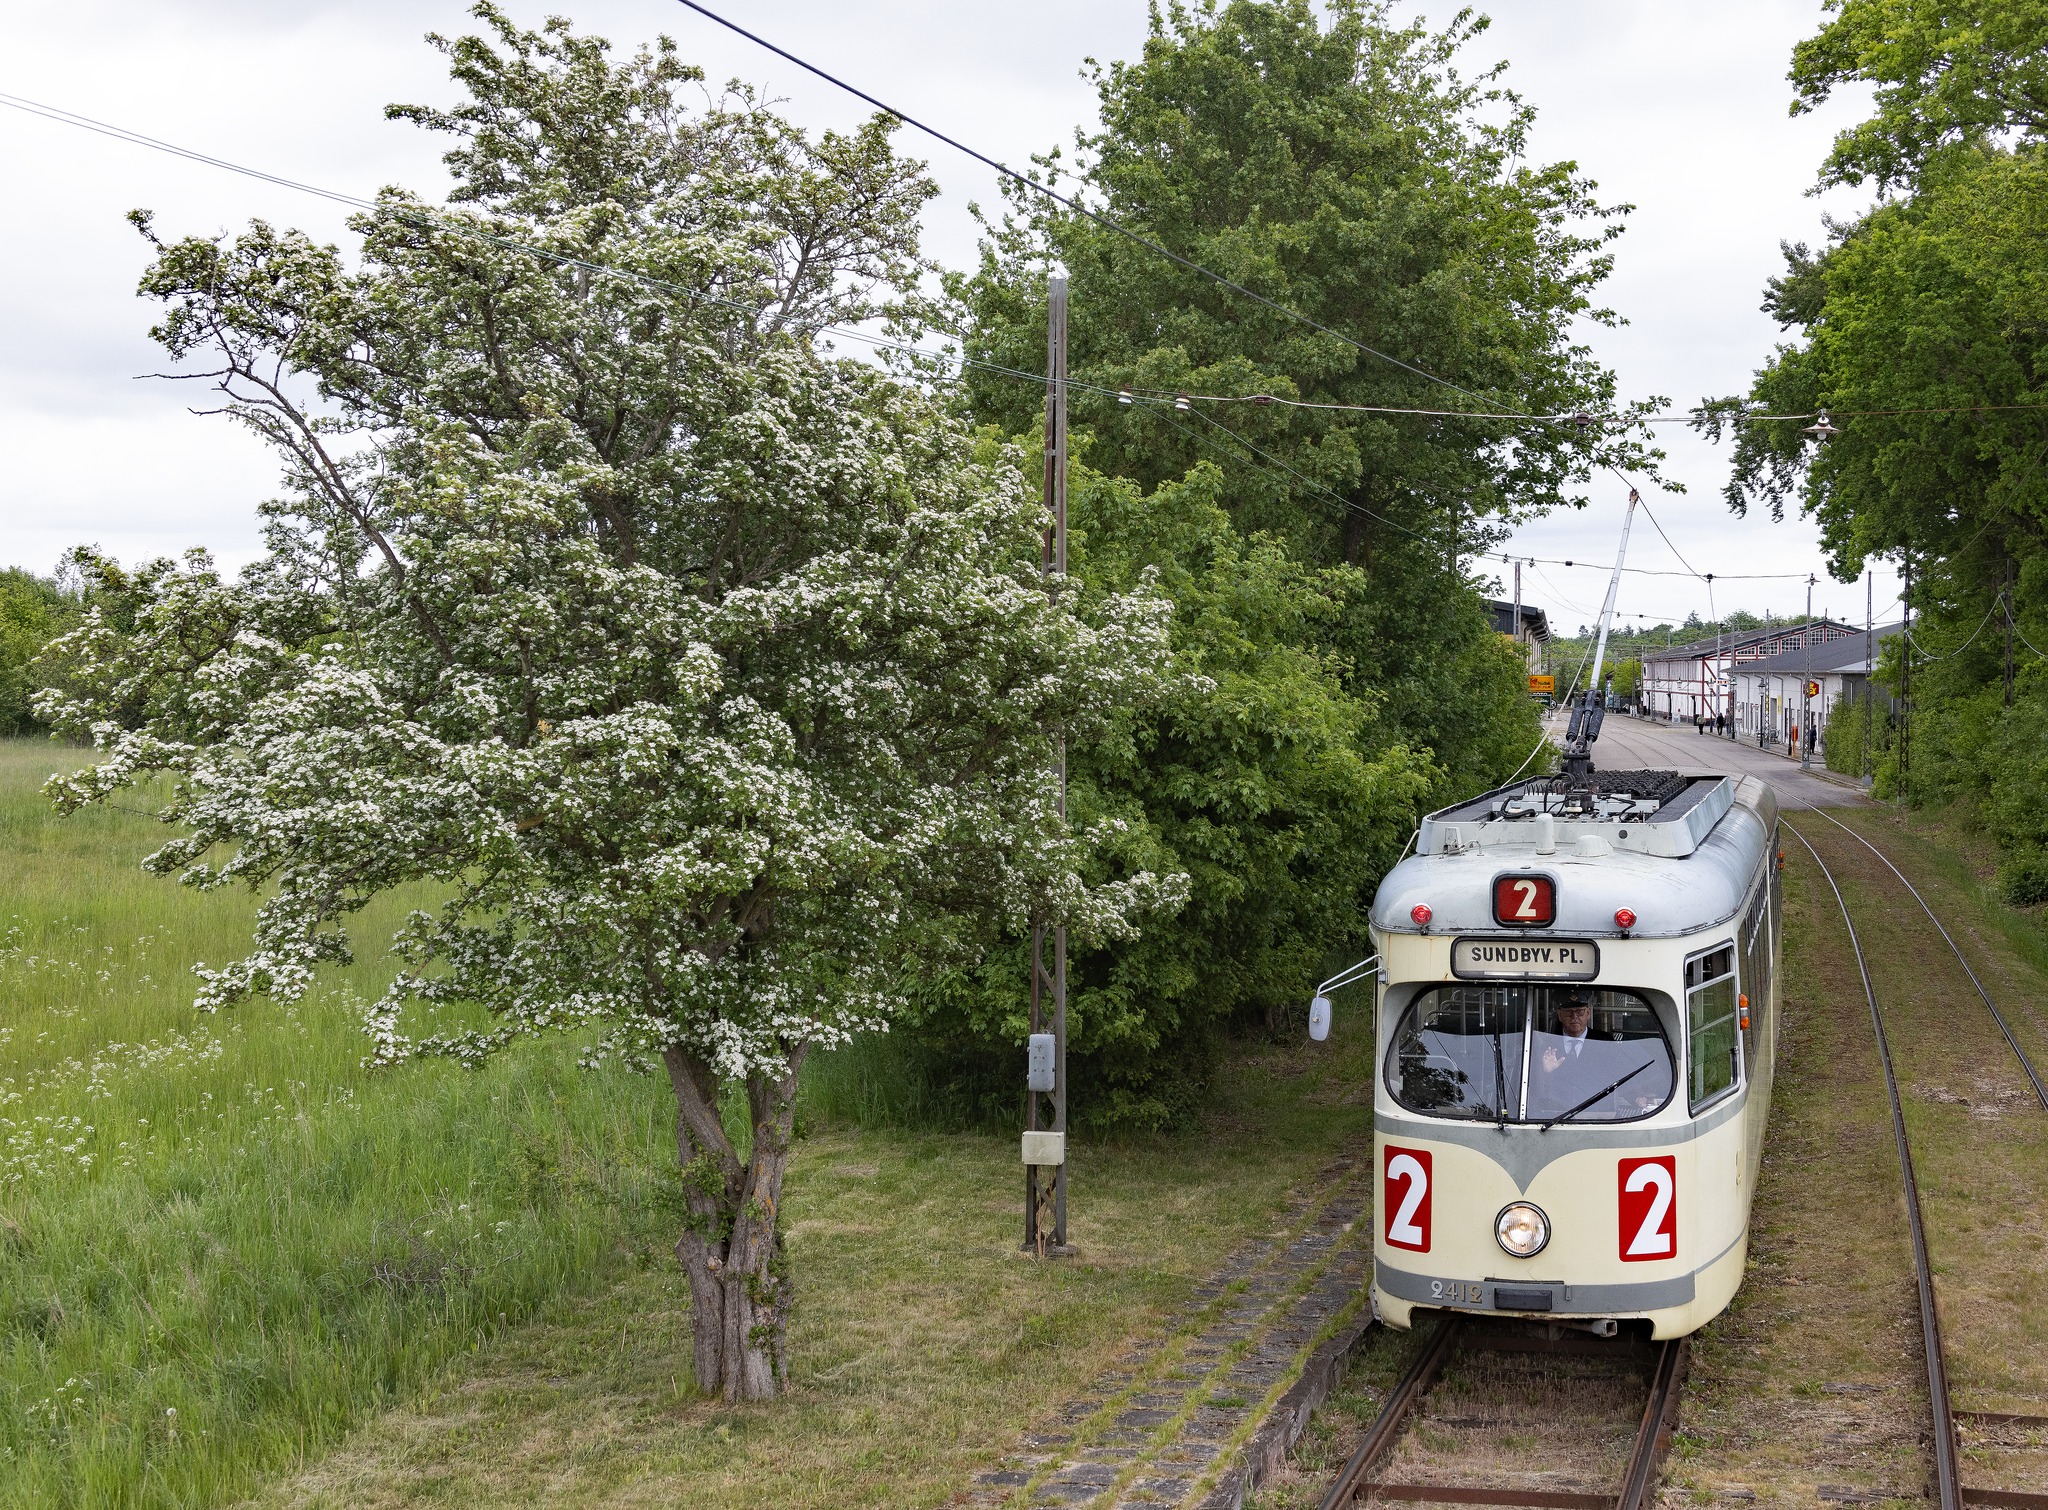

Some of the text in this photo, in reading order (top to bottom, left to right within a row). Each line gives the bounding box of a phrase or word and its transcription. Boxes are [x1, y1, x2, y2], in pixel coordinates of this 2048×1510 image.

[1513, 879, 1537, 917] 2
[1471, 947, 1583, 964] SUNDBYV. PL.
[1387, 1154, 1427, 1246] 2
[1625, 1163, 1673, 1255] 2
[1431, 1280, 1483, 1303] 2412
